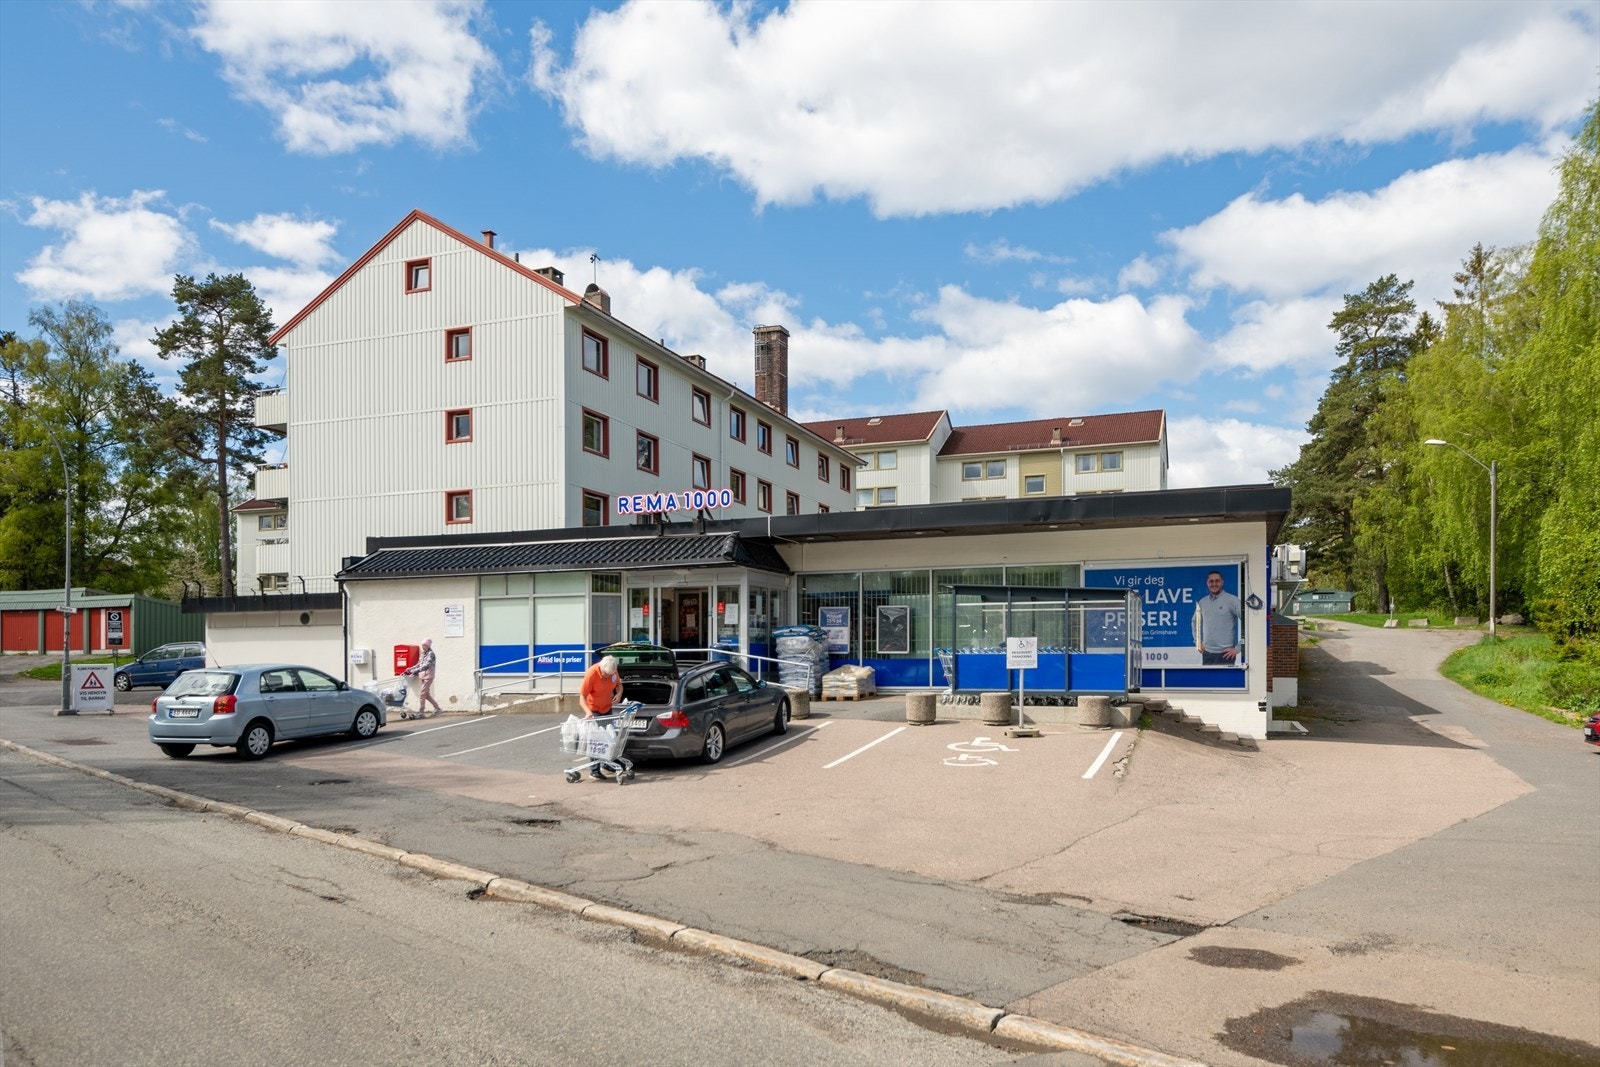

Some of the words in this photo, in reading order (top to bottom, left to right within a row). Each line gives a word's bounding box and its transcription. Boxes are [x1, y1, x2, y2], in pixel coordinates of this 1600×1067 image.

[617, 492, 677, 514] REMA
[683, 489, 732, 509] 1000
[1114, 576, 1125, 585] Vi
[1128, 576, 1142, 587] gir
[1144, 576, 1165, 586] deg
[1145, 588, 1193, 604] LAVE
[1145, 653, 1169, 661] 1000
